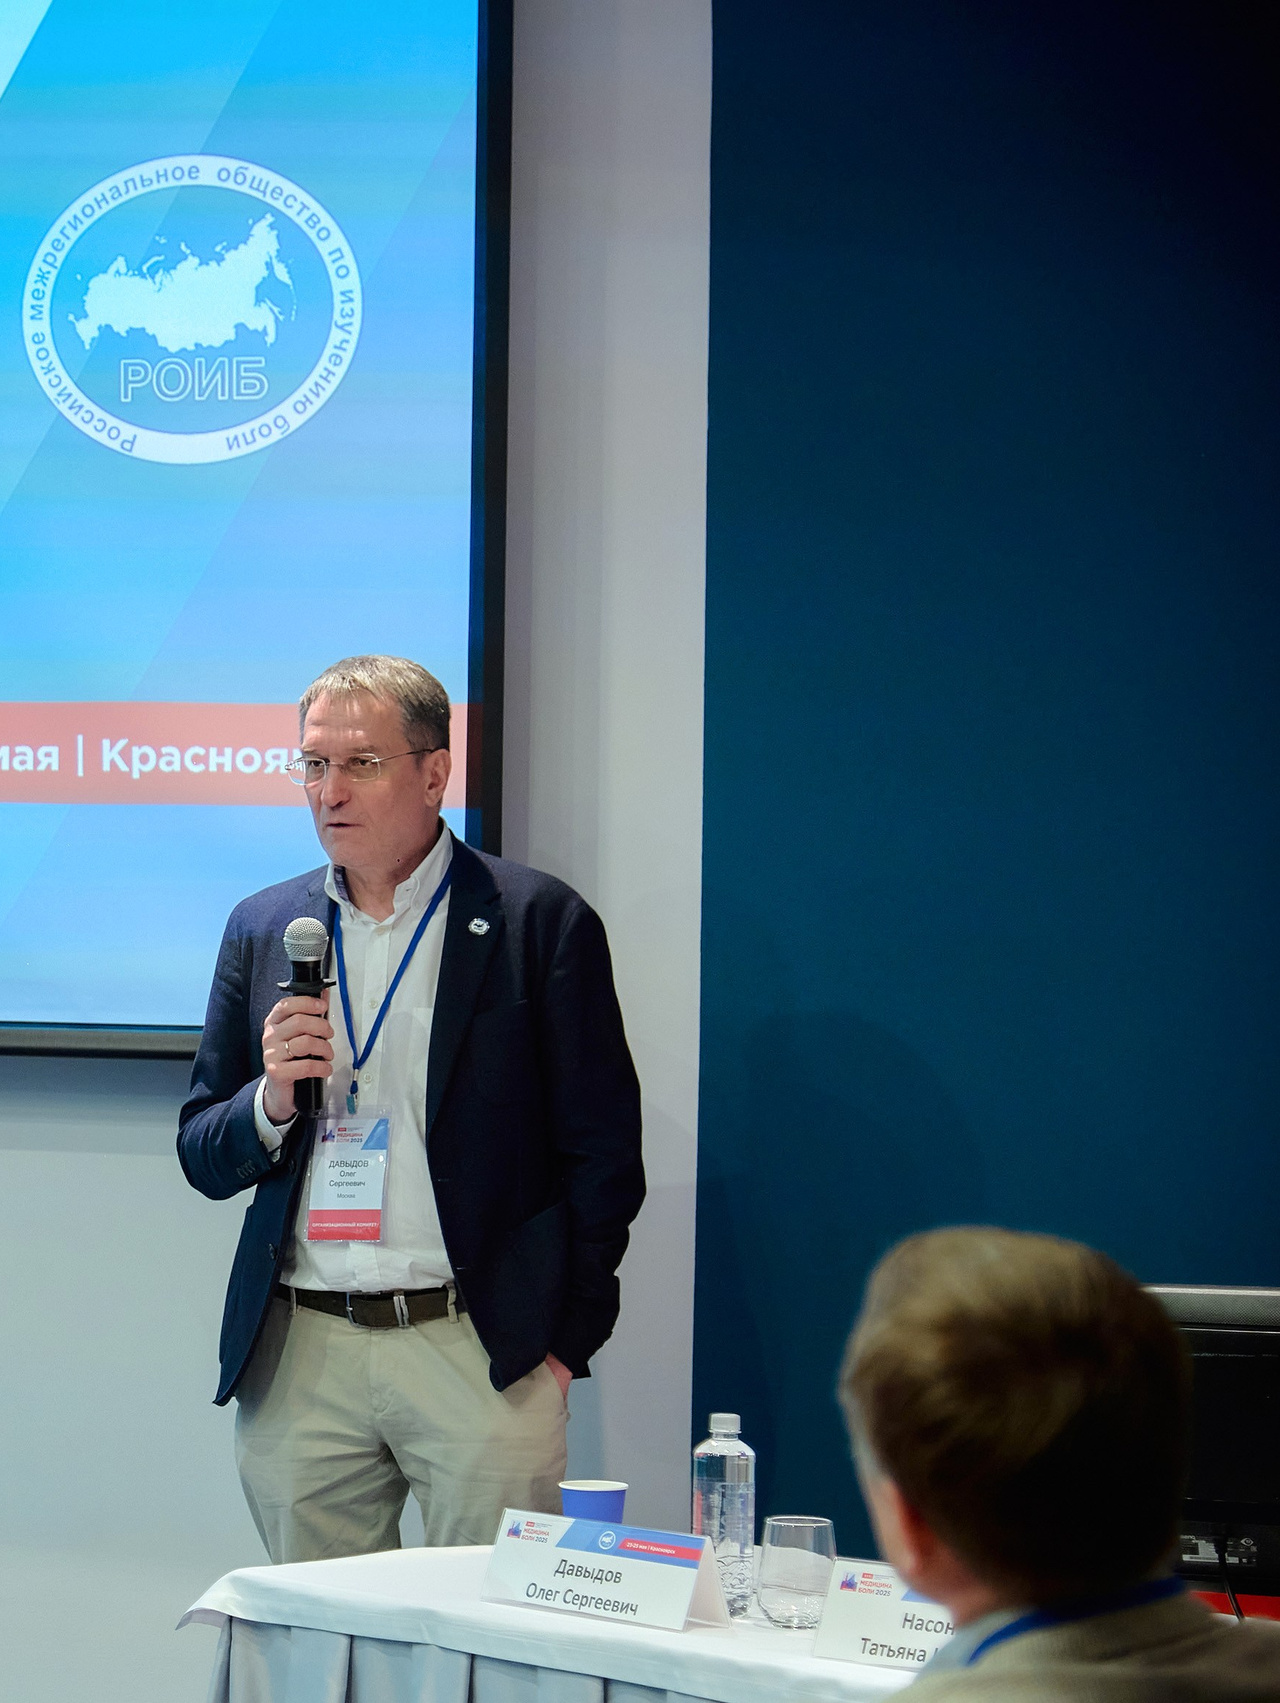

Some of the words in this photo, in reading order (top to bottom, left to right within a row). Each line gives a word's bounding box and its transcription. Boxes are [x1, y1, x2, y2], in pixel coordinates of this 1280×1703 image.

[216, 165, 332, 244] общество
[29, 163, 200, 321] межрегиональное
[327, 247, 350, 280] по
[292, 288, 355, 415] изучению
[30, 331, 138, 453] Российское
[119, 356, 269, 402] РОИБ
[225, 414, 291, 451] боли
[328, 1160, 369, 1169] ДАВЫДОВ
[339, 1170, 357, 1178] Олег
[328, 1180, 366, 1188] Сергеевич
[553, 1558, 623, 1584] Давыдов
[525, 1582, 561, 1602] Олег
[562, 1589, 639, 1616] Сергеевич
[875, 1589, 891, 1597] 2025
[861, 1637, 927, 1663] Татьяна
